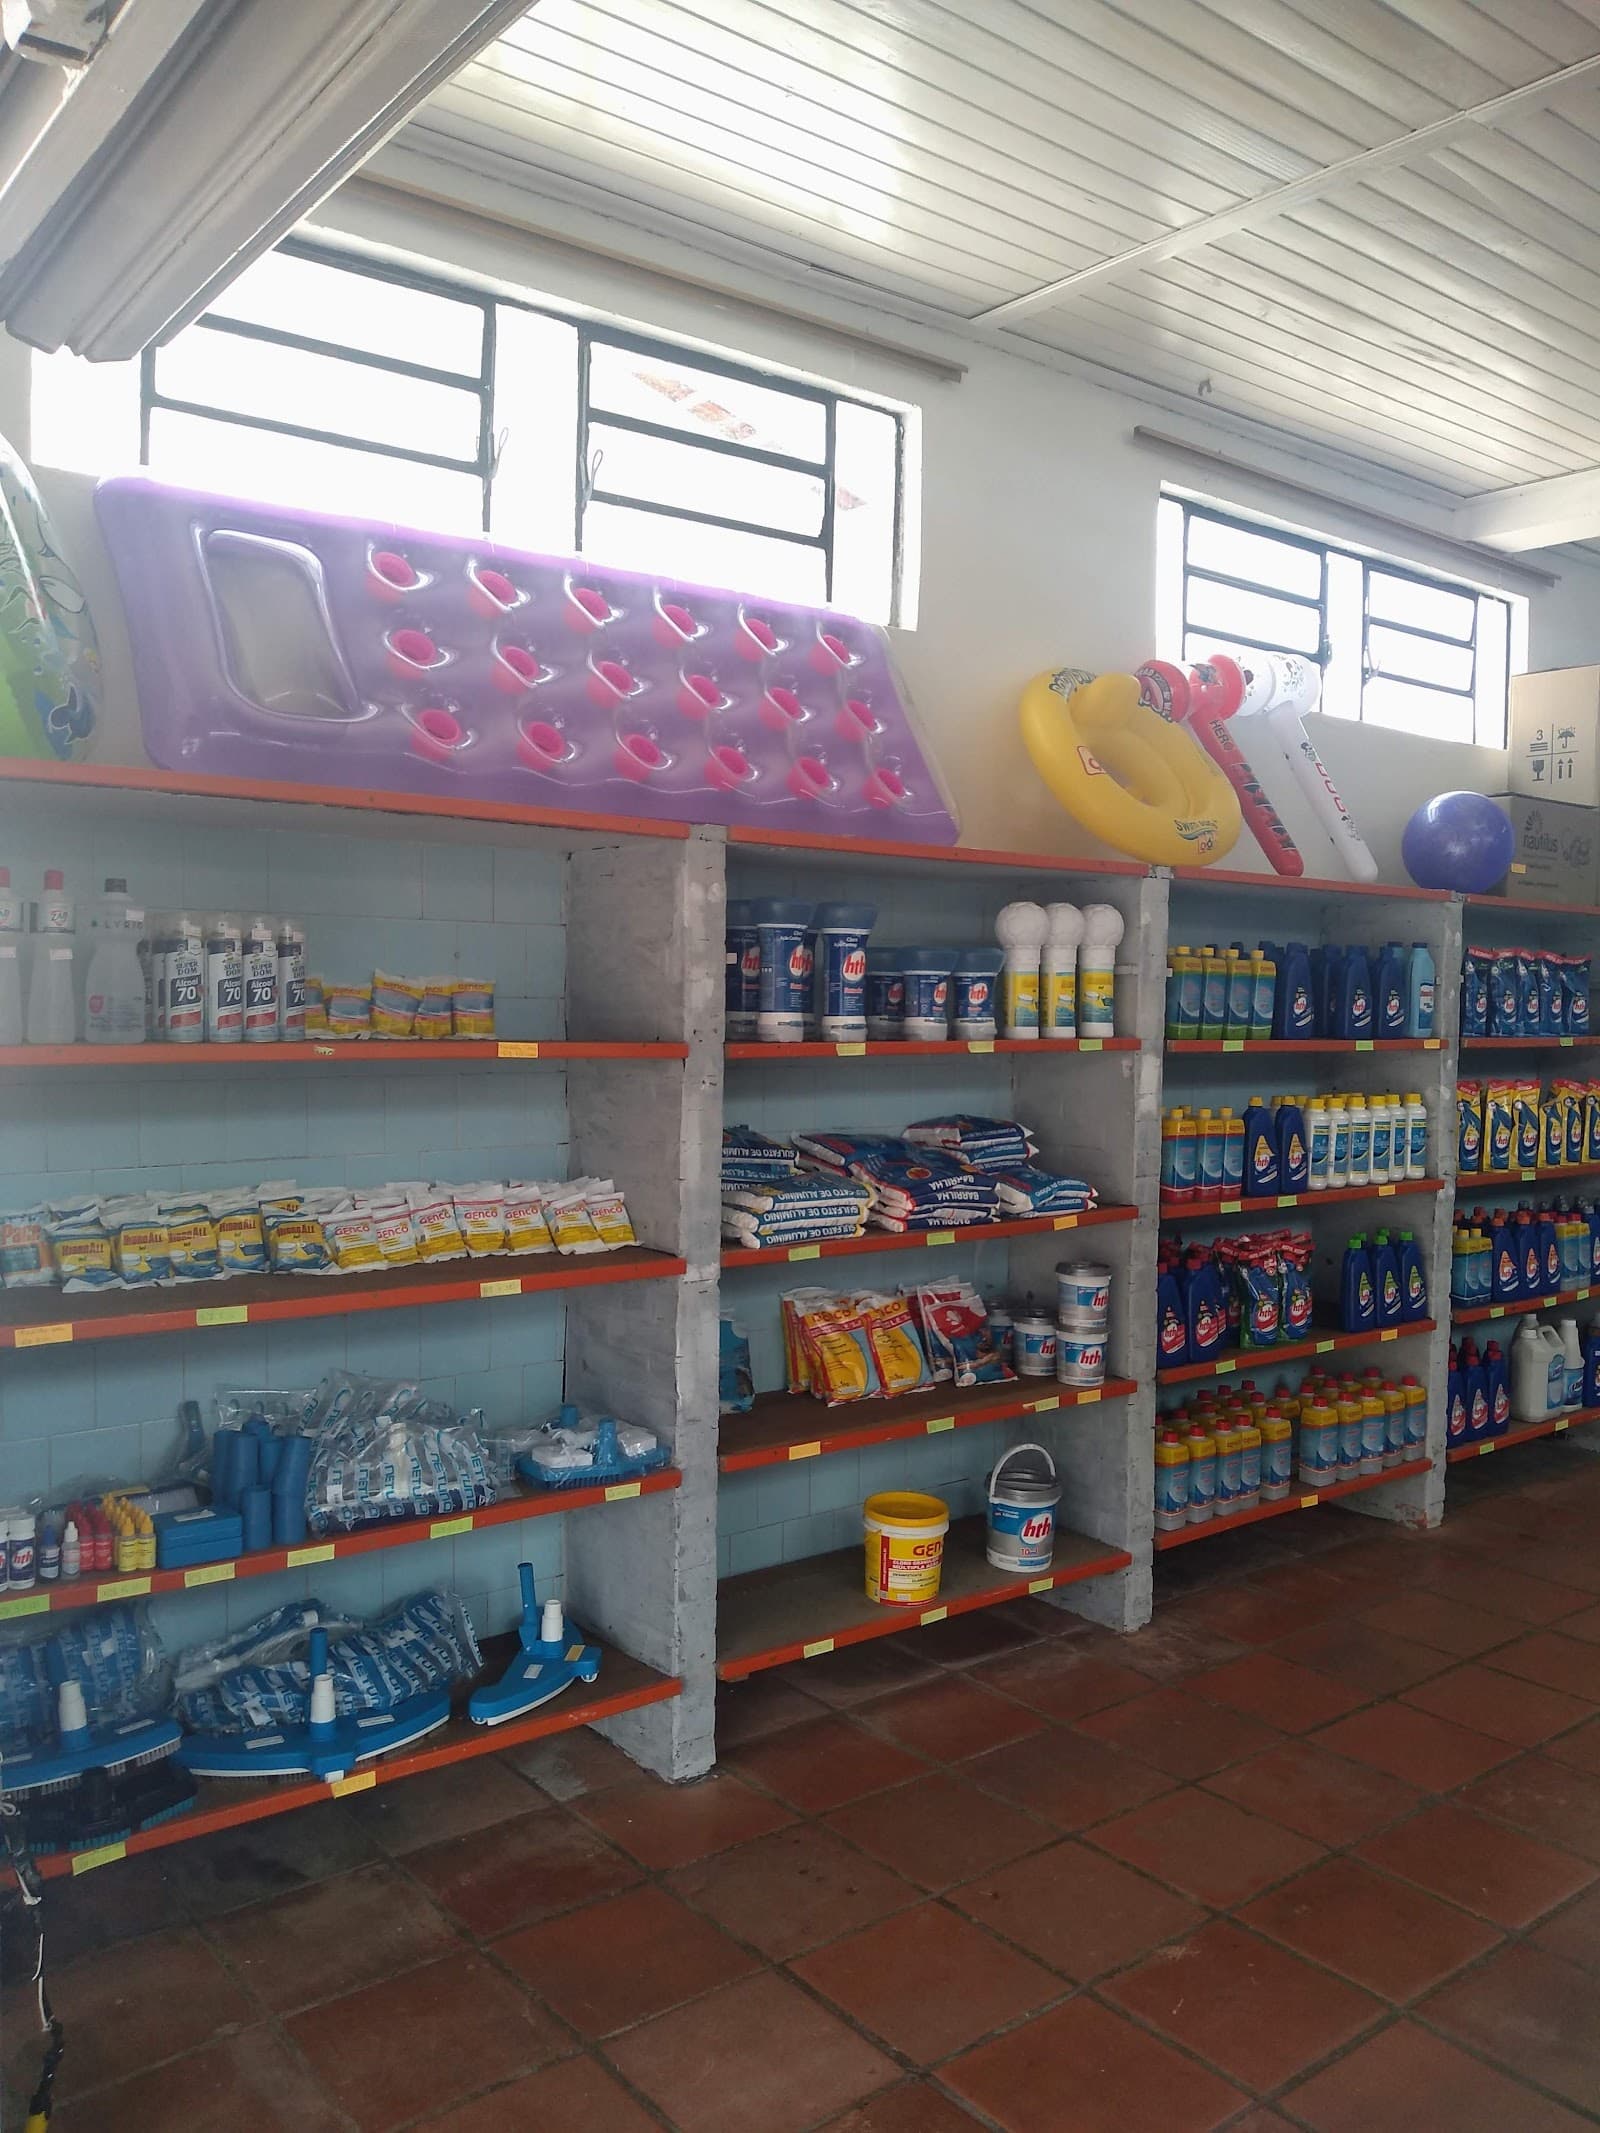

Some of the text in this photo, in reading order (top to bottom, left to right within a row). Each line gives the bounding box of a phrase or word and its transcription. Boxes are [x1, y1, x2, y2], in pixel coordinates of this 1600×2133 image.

[1209, 719, 1234, 751] HERO
[1536, 729, 1544, 741] 3
[177, 967, 198, 976] DOM
[253, 969, 273, 977] DOM
[177, 986, 197, 1002] 70
[225, 986, 241, 1003] 70
[252, 987, 271, 1003] 70
[722, 1147, 751, 1157] ALUMÍN
[751, 1148, 762, 1157] DE
[928, 1173, 975, 1190] BARRILHA
[821, 1189, 832, 1198] DE
[936, 1191, 979, 1201] BARRILHA
[419, 1211, 451, 1224] GENCO
[464, 1207, 498, 1219] GENCO
[505, 1206, 539, 1219] GENCO
[591, 1206, 623, 1217] GENCO
[763, 1206, 859, 1222] SULFATO DE ALUMÍNIO
[335, 1223, 370, 1236] GENCO
[809, 1228, 822, 1238] DE
[766, 1230, 808, 1244] ALUMÍNIO
[1079, 1350, 1102, 1365] hth
[431, 1452, 453, 1512] NETUNO
[1023, 1516, 1051, 1538] hth
[912, 1541, 941, 1557] GEN
